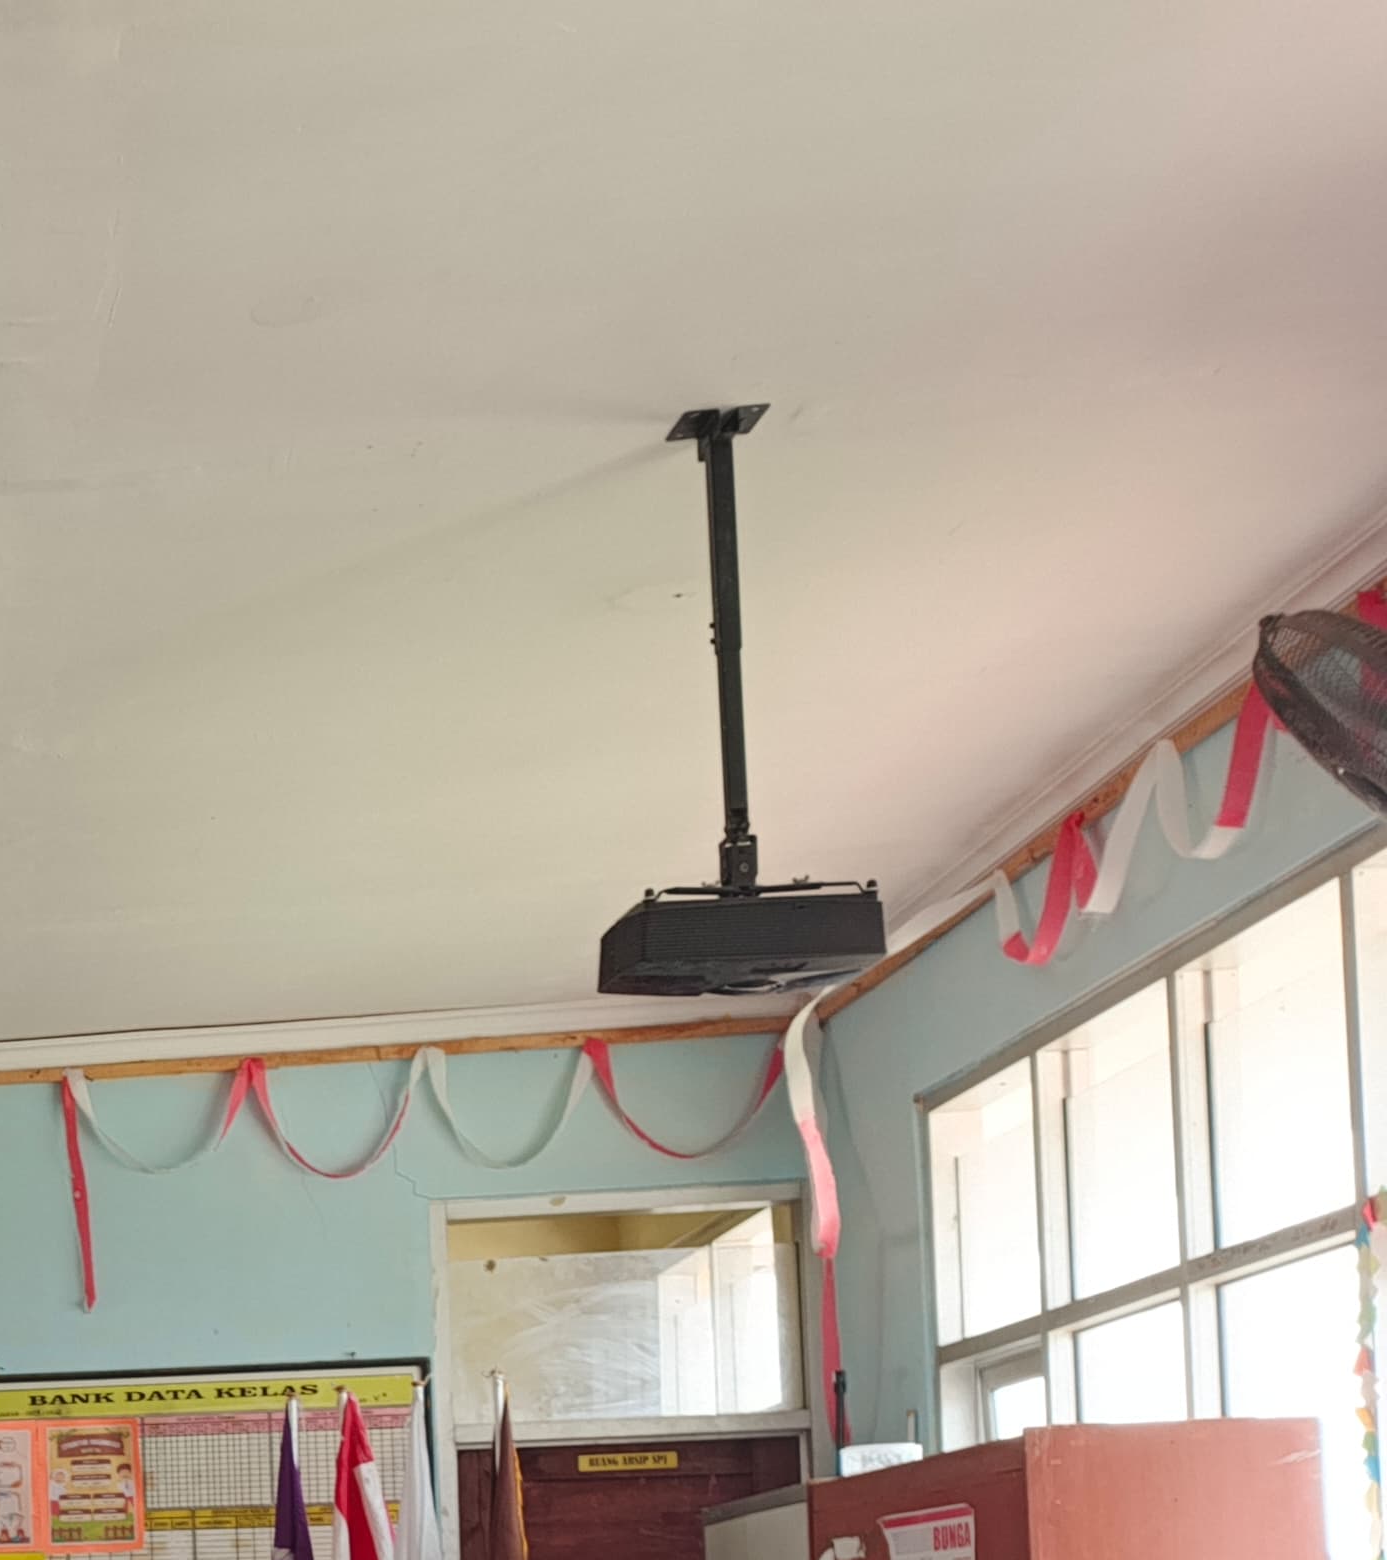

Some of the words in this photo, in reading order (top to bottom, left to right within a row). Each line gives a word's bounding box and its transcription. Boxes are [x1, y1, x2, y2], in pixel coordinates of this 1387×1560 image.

[28, 1391, 115, 1407] BANK
[124, 1388, 204, 1403] DATA
[213, 1383, 319, 1400] KELAS
[933, 1522, 971, 1552] BUNGA
